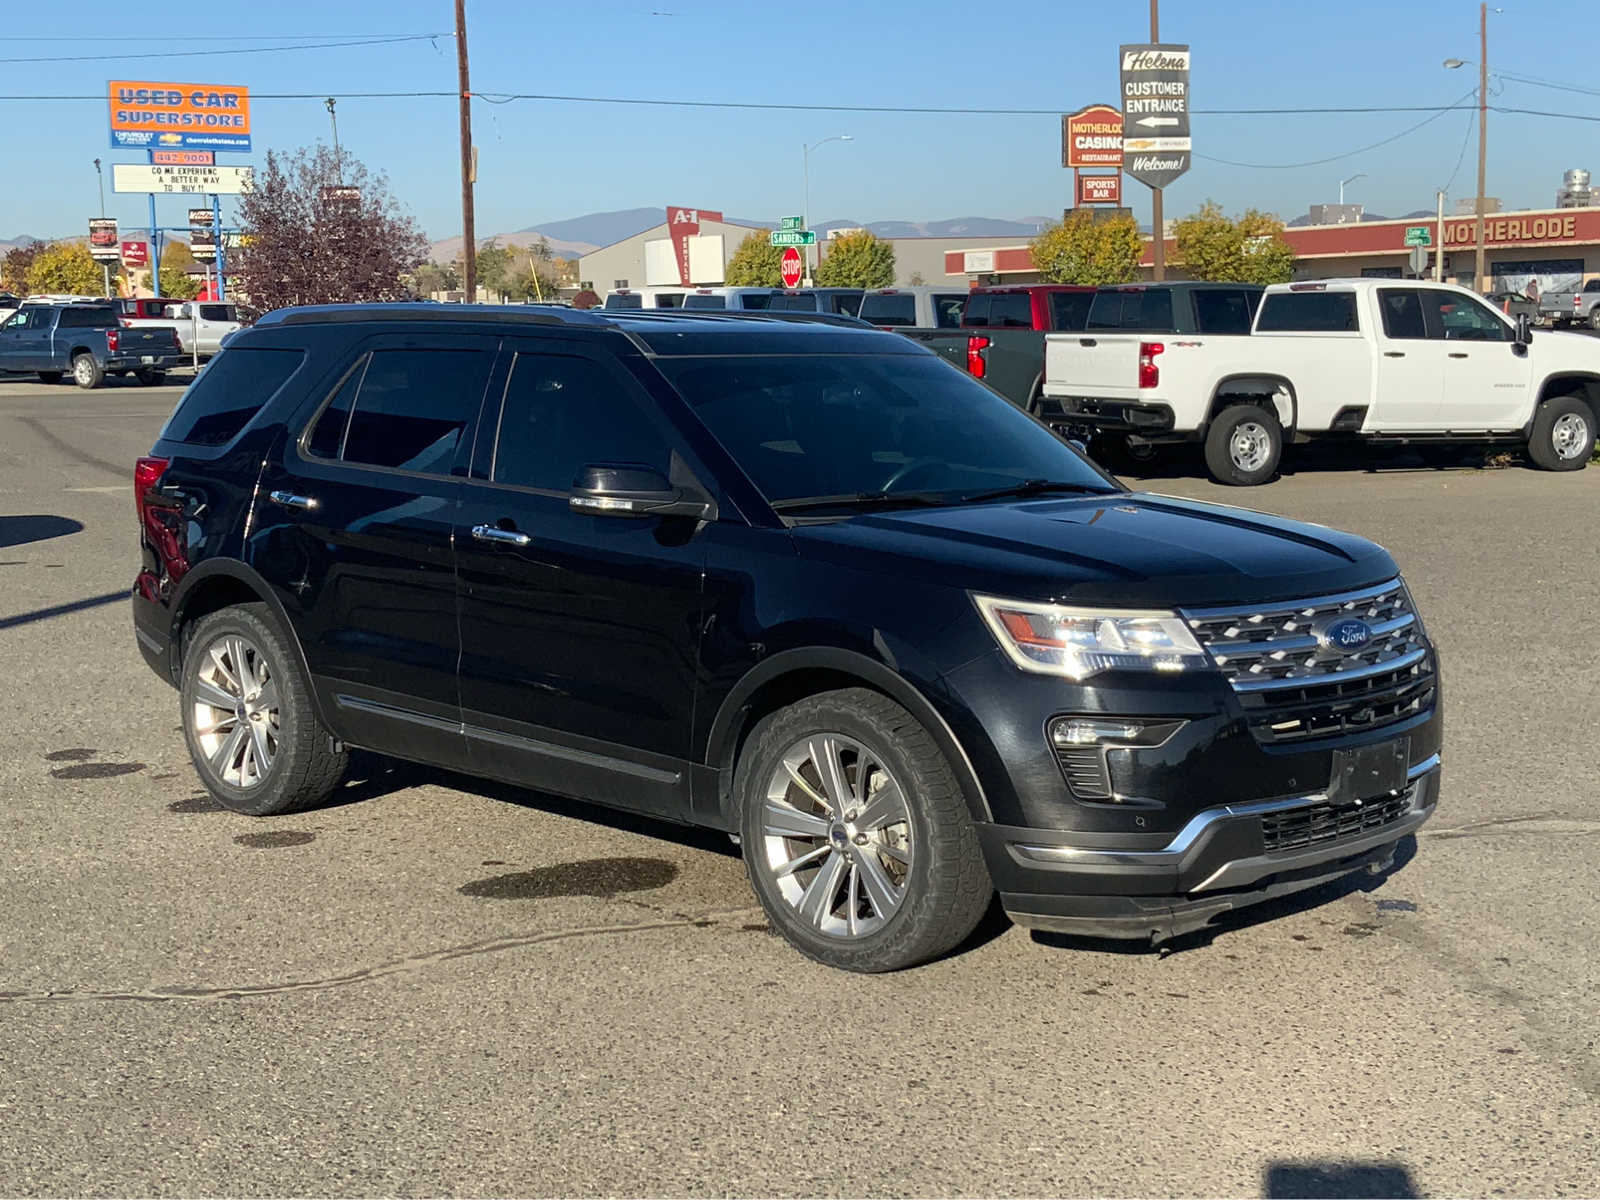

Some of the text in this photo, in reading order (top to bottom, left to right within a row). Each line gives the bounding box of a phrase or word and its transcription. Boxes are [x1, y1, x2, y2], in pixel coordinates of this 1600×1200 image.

[1128, 52, 1185, 70] Helena
[1125, 82, 1185, 96] CUSTOMER
[118, 88, 240, 110] USED CAR
[1126, 99, 1185, 113] ENTRANCE
[116, 110, 246, 127] SUPERSTORE
[1132, 156, 1185, 171] Welcome!
[170, 175, 199, 184] BETTER
[1086, 181, 1116, 189] SPORTS
[1093, 190, 1110, 198] BAR
[1442, 216, 1577, 244] MOTHERLODE
[773, 232, 804, 244] SANDERS
[783, 260, 800, 275] STOP
[1341, 624, 1366, 645] Ford
